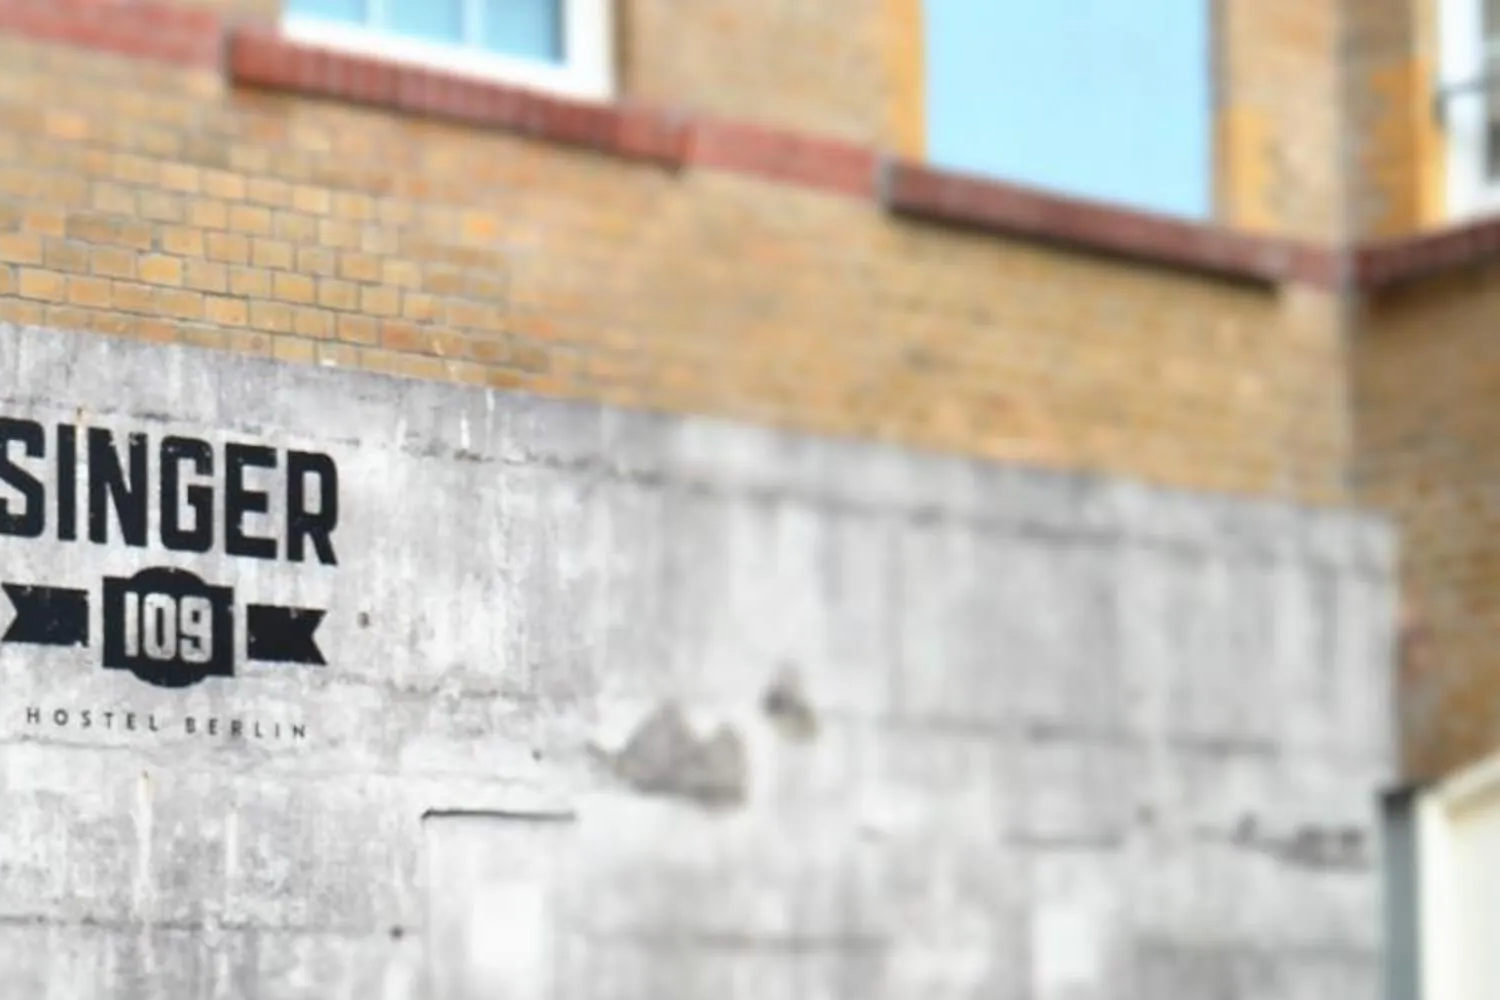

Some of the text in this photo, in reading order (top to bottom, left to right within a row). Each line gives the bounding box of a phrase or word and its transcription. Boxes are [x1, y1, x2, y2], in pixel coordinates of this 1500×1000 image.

[124, 591, 213, 663] 109
[26, 707, 306, 739] HOSTEL BERLIN
